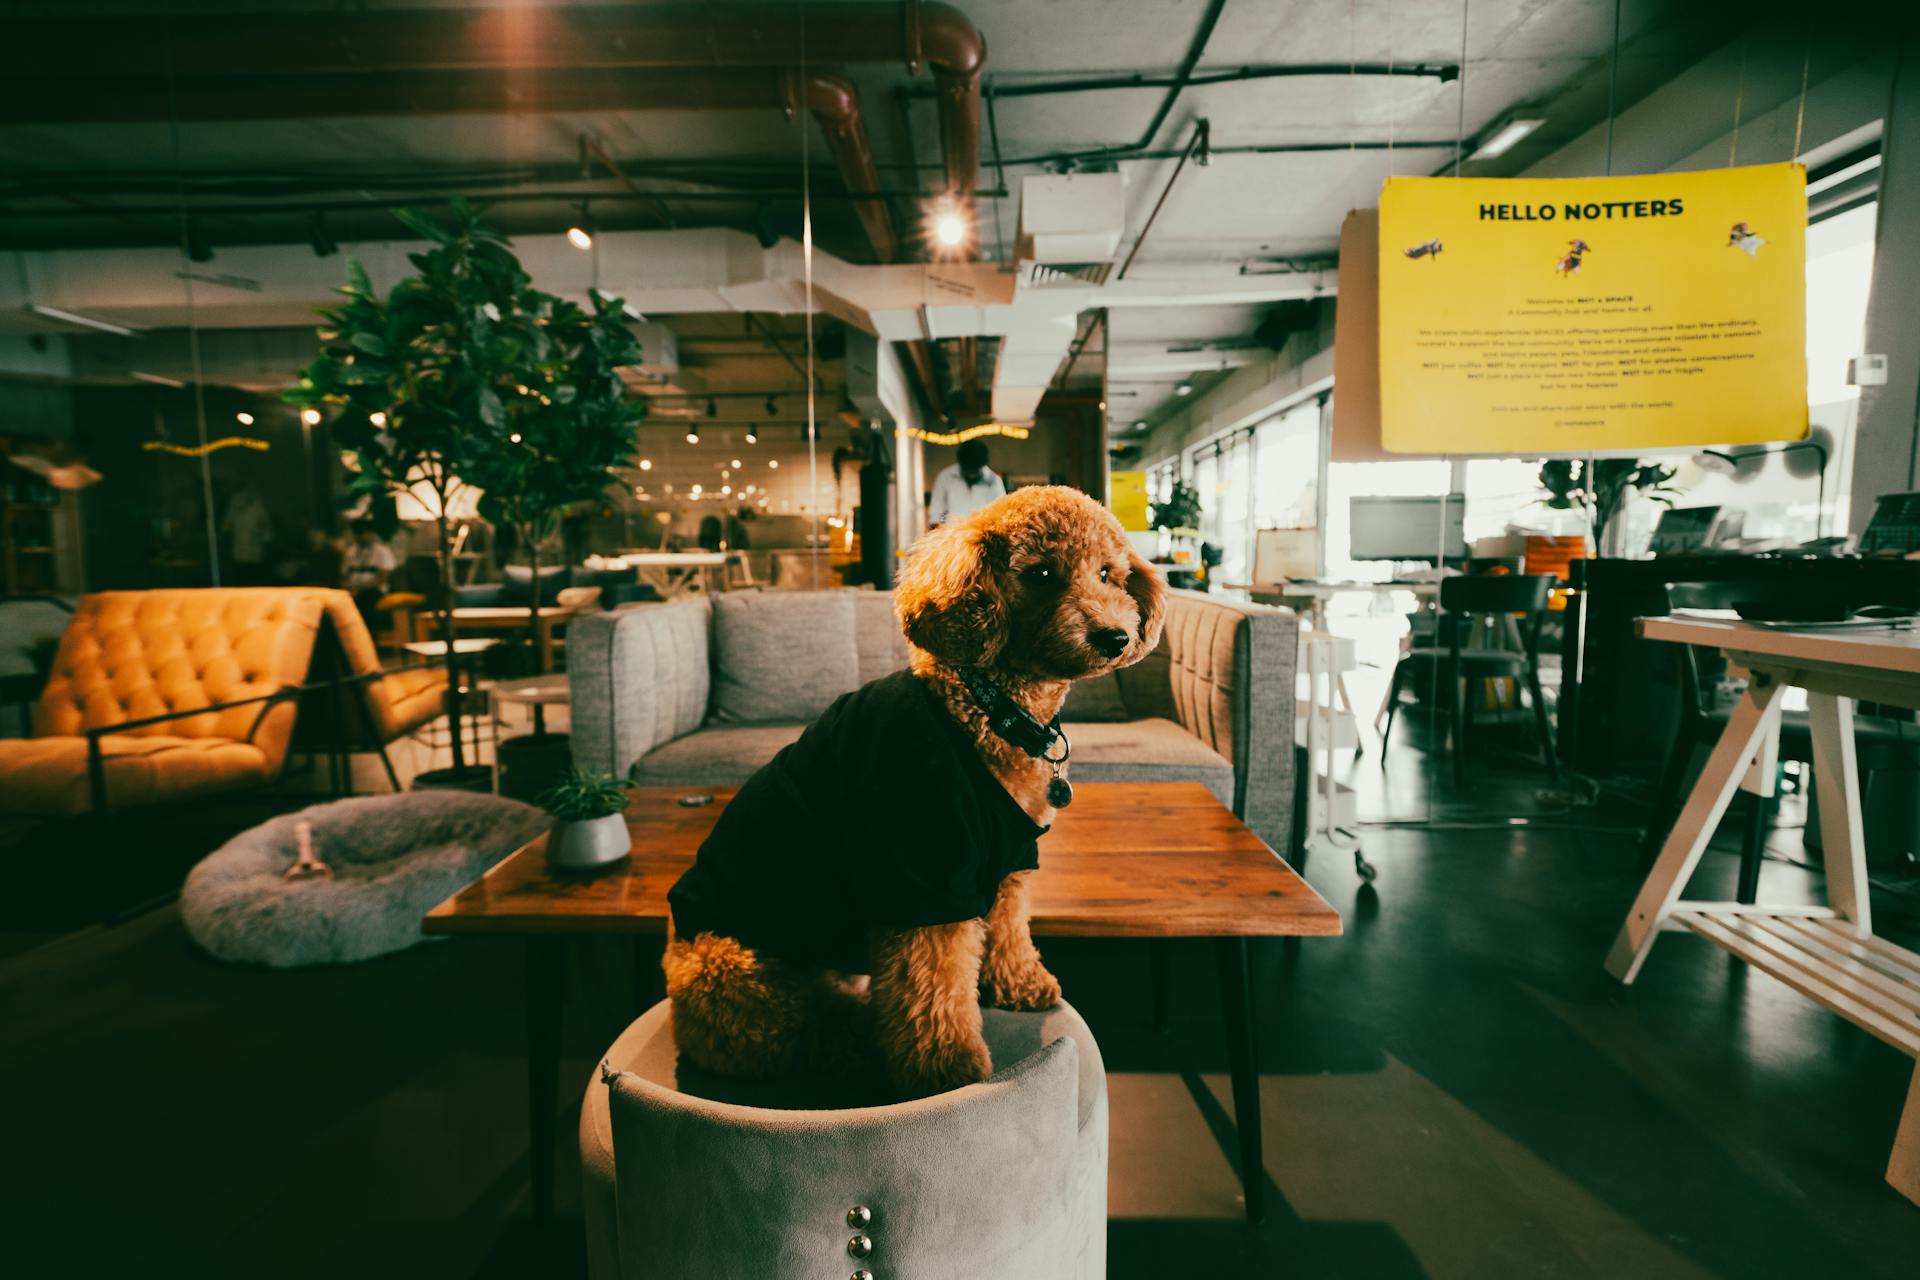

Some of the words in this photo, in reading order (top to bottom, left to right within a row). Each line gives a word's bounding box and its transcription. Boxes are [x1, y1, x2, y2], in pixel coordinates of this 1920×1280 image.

[1480, 204, 1555, 220] HELLO
[1565, 199, 1683, 219] NOTTERS
[1602, 325, 1648, 335] something
[1676, 323, 1697, 331] than
